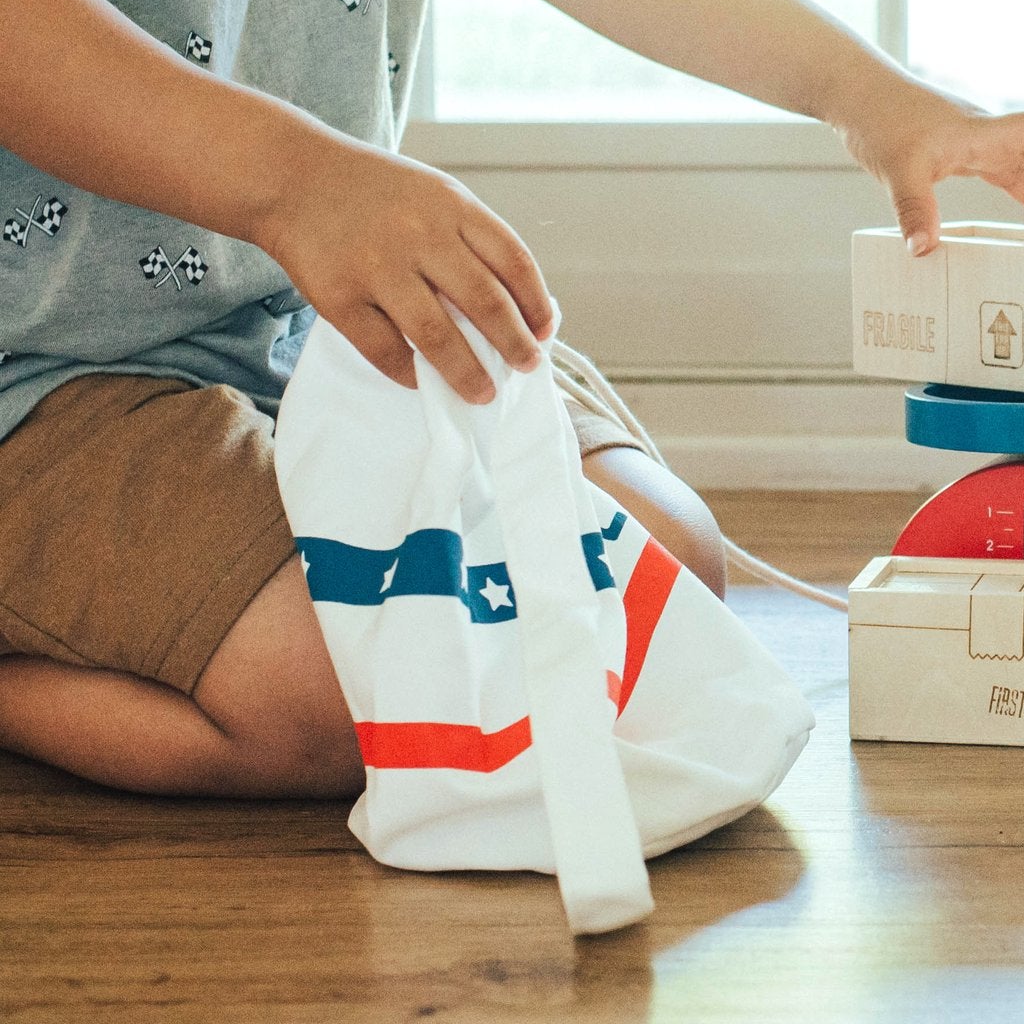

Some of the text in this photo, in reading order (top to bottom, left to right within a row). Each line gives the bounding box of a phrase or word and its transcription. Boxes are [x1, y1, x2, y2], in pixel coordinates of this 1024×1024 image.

[863, 310, 936, 353] FRAGILE
[987, 506, 992, 518] 1
[986, 538, 994, 552] 2
